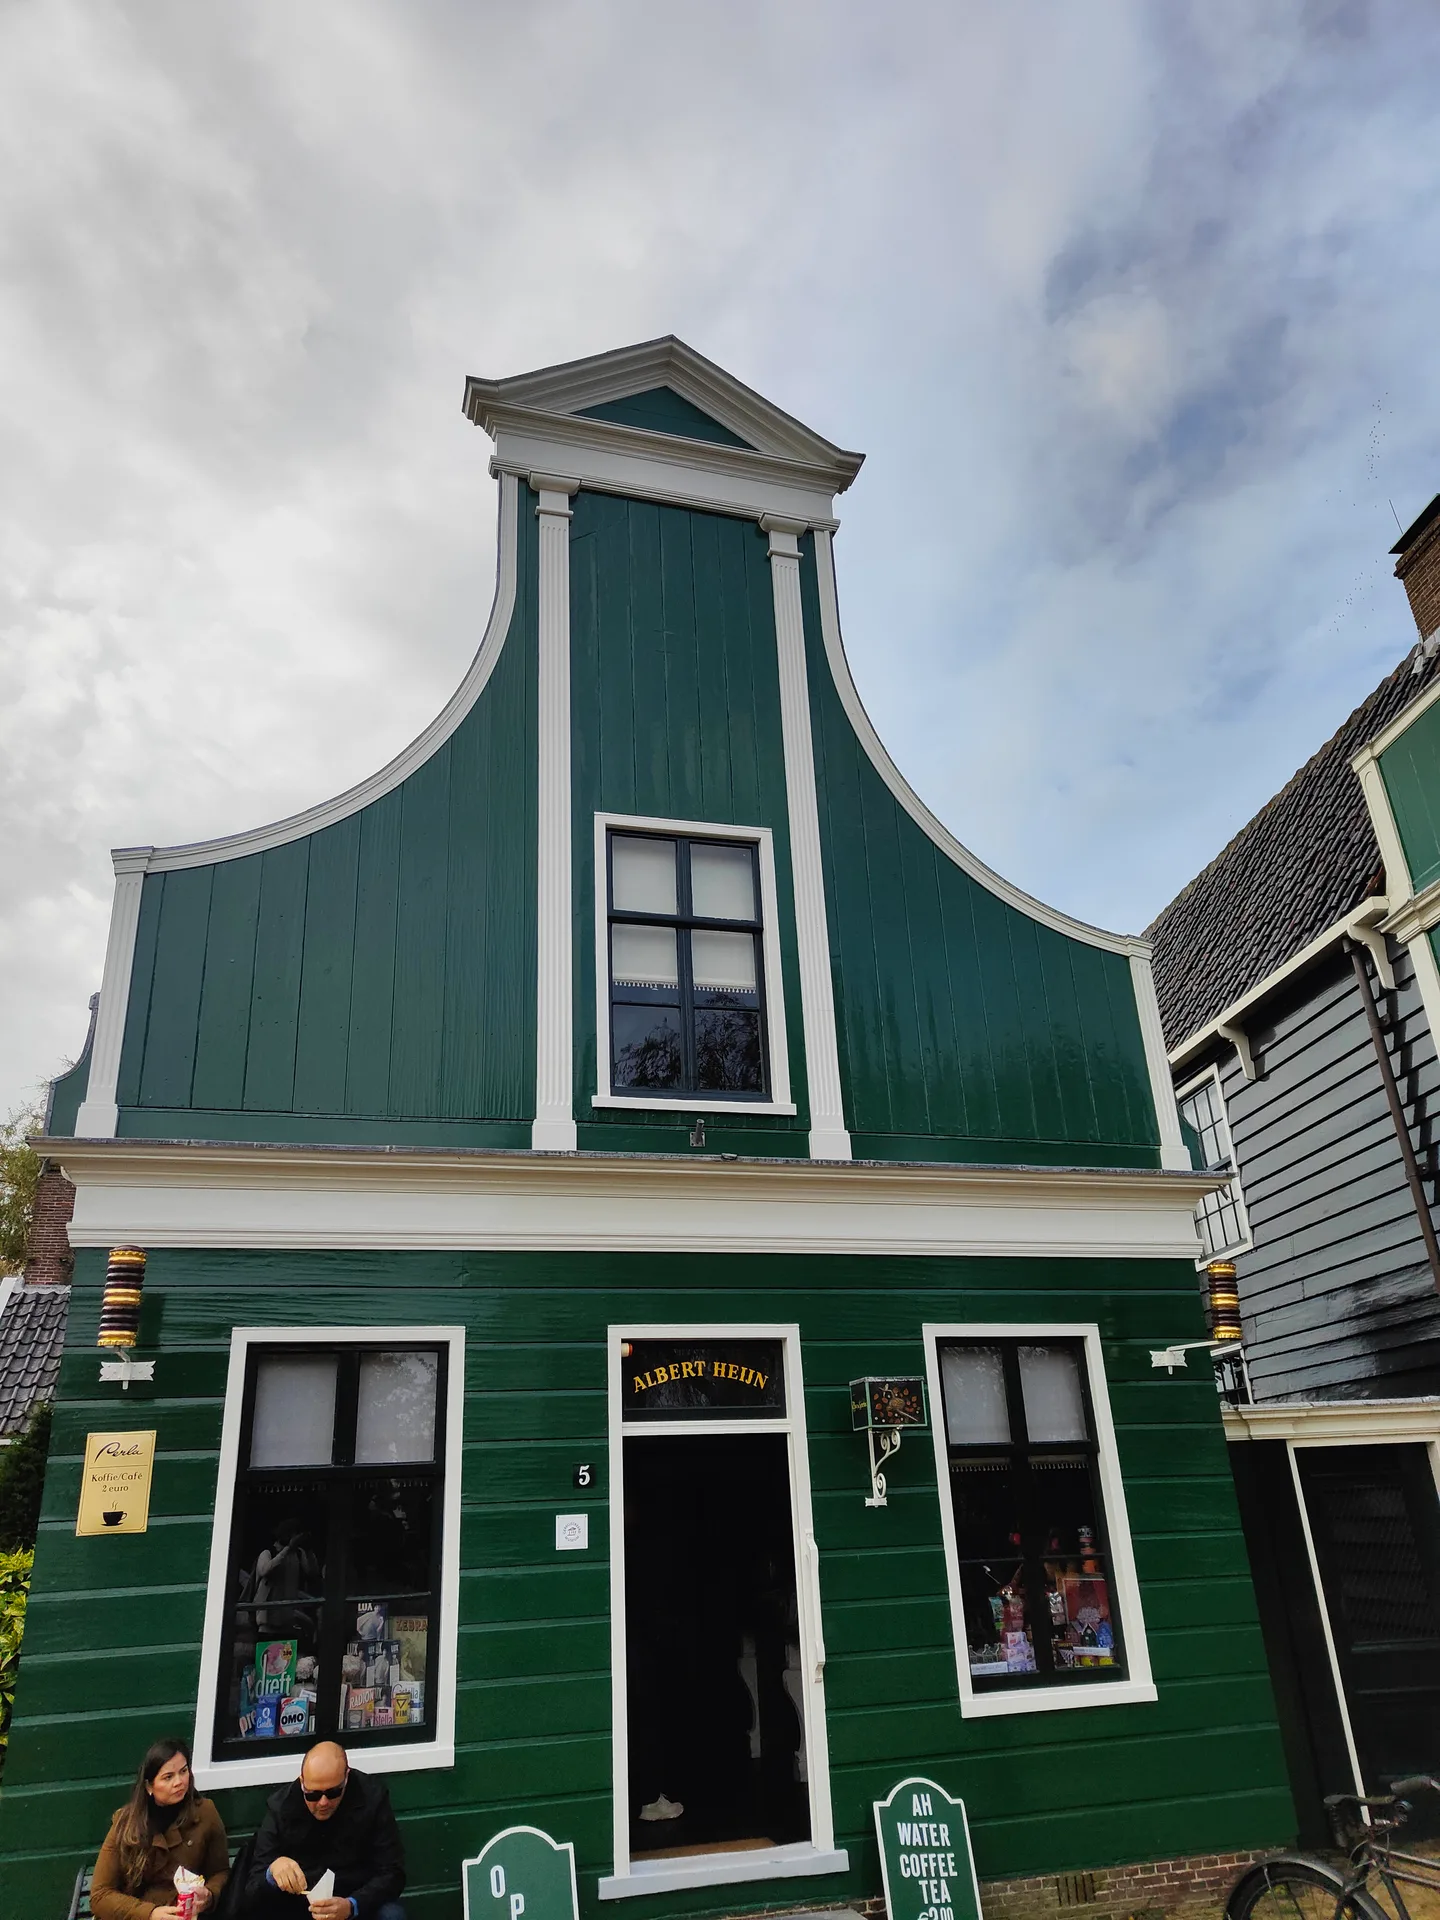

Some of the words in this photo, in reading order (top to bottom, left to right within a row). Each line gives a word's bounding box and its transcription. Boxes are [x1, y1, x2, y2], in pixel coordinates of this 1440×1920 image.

[633, 1360, 706, 1393] ALBERT
[713, 1361, 769, 1390] HEIJN
[94, 1441, 143, 1463] Perla
[91, 1471, 143, 1482] Koffie/Café
[578, 1464, 590, 1486] 5
[102, 1484, 108, 1493] 2
[358, 1602, 373, 1612] LUX
[396, 1619, 428, 1632] ZEBRA
[347, 1643, 359, 1656] LUX
[256, 1654, 292, 1698] dreft
[281, 1713, 304, 1725] OMO
[912, 1793, 933, 1816] AH
[896, 1822, 951, 1847] WATER
[899, 1853, 958, 1878] COFFEE
[918, 1879, 952, 1904] TEA
